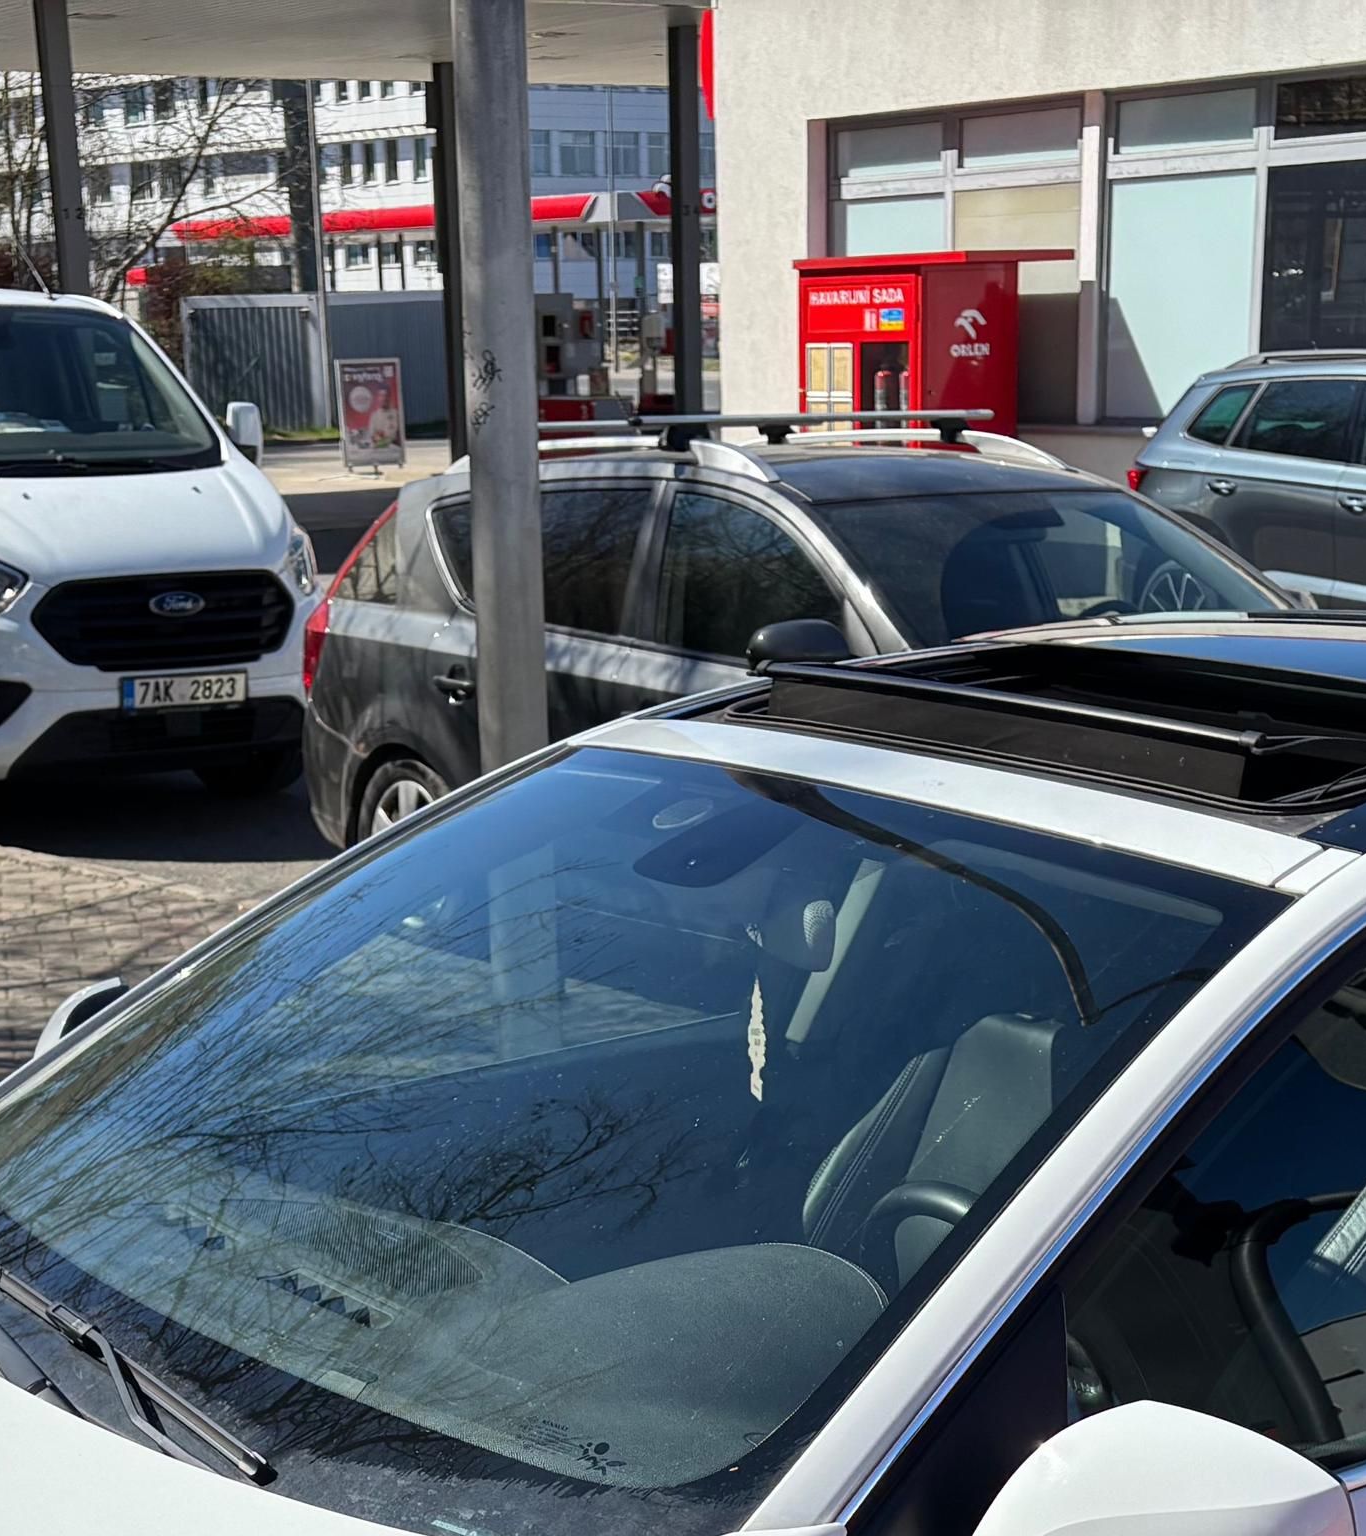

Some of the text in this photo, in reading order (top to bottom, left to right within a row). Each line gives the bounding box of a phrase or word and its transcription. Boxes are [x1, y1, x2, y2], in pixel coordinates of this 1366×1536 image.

[871, 287, 905, 305] SADA
[950, 342, 991, 358] ORLEN
[162, 595, 196, 612] Ford
[138, 676, 237, 705] 7AK 2823
